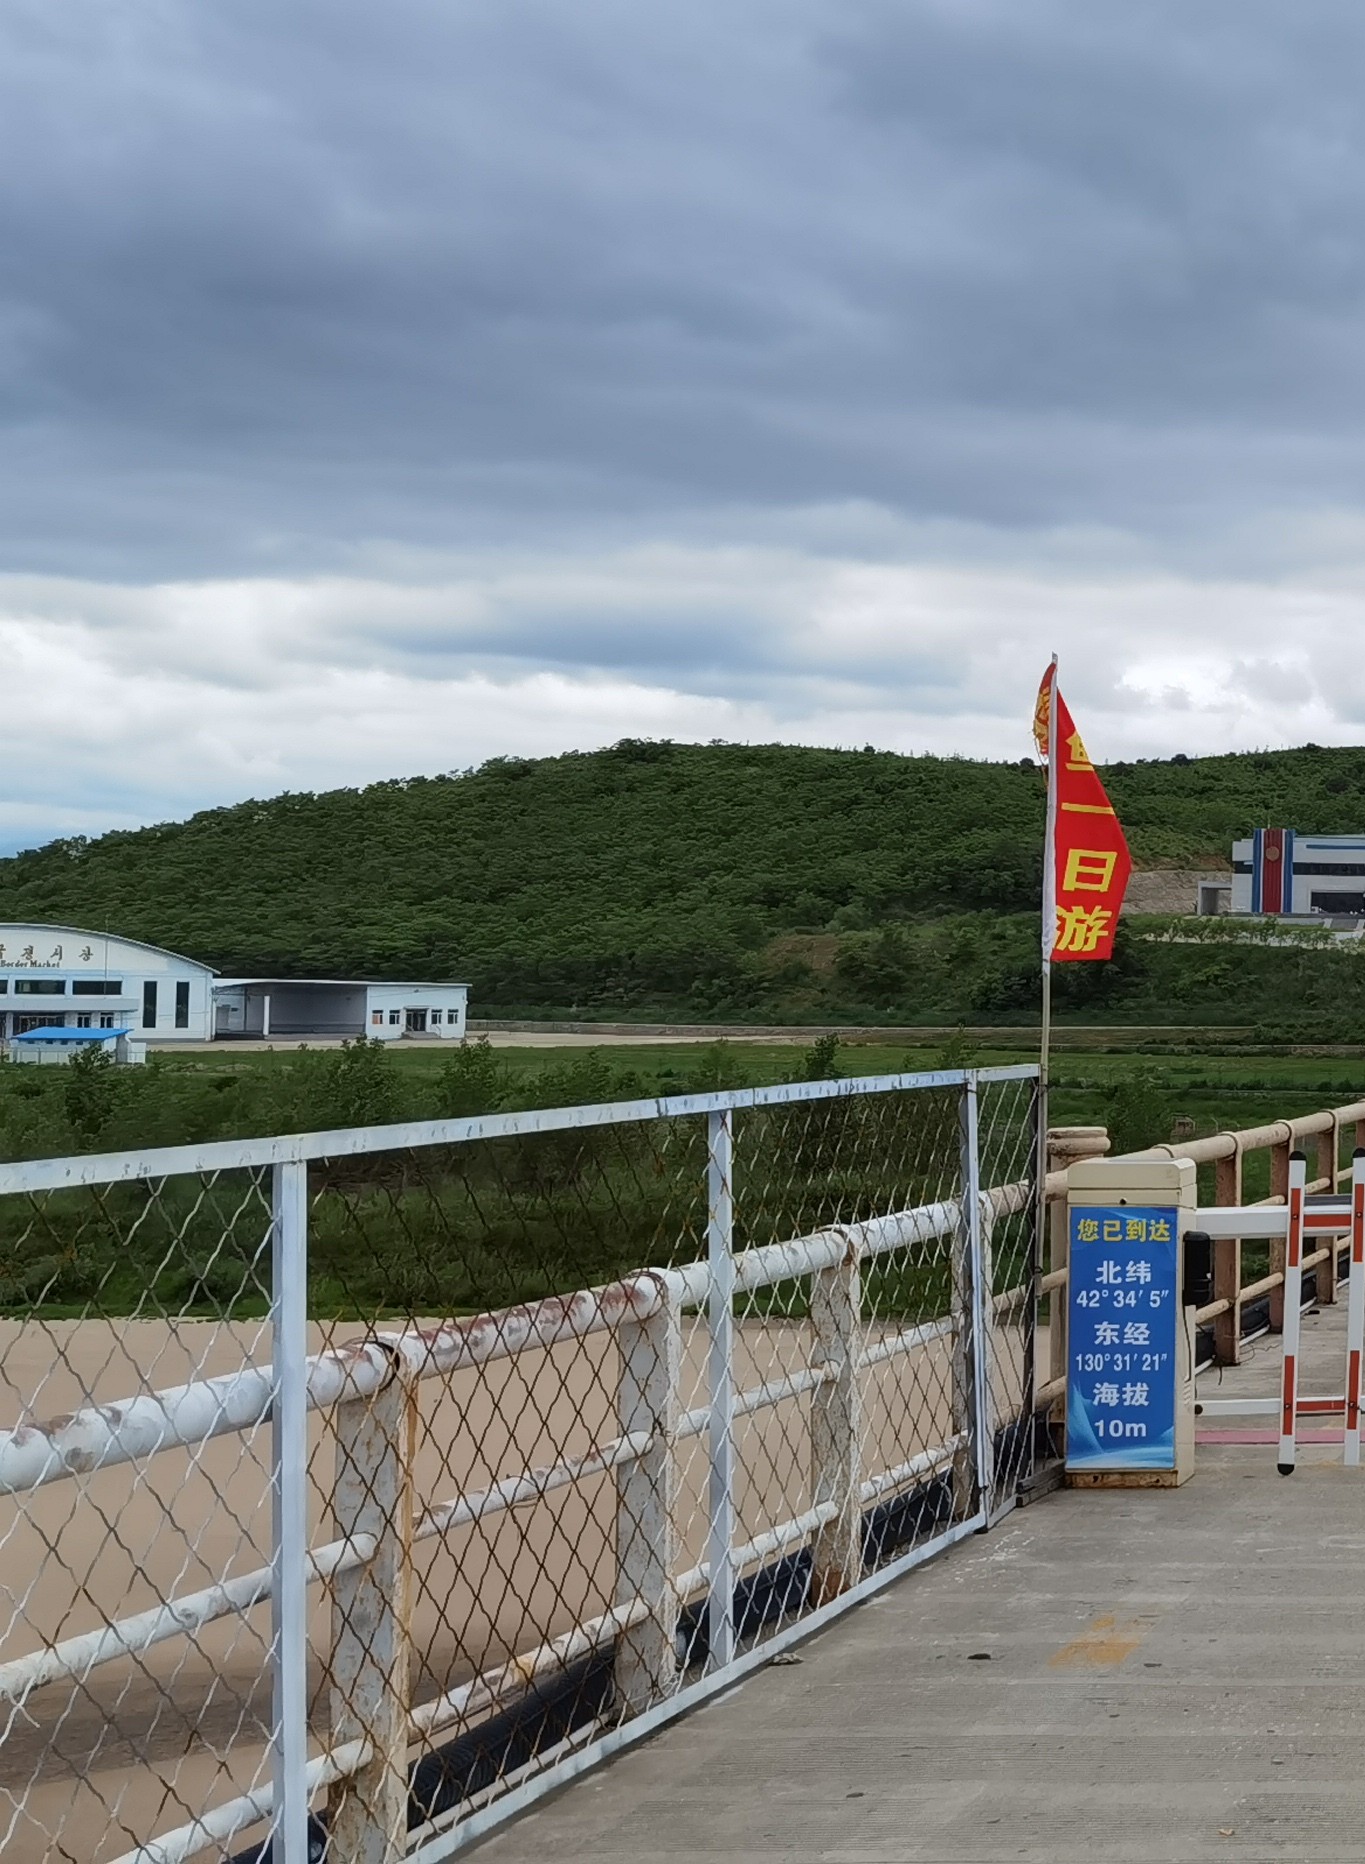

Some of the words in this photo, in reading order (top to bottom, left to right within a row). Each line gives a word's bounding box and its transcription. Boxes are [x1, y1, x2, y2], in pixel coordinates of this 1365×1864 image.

[0, 960, 28, 968] Border
[29, 960, 60, 969] Market
[1077, 1218, 1171, 1242] 您已到达
[1095, 1260, 1152, 1285] 北纬
[1094, 1321, 1151, 1346] 东经
[1092, 1382, 1150, 1407] 海拔
[1094, 1419, 1147, 1437] 10m
